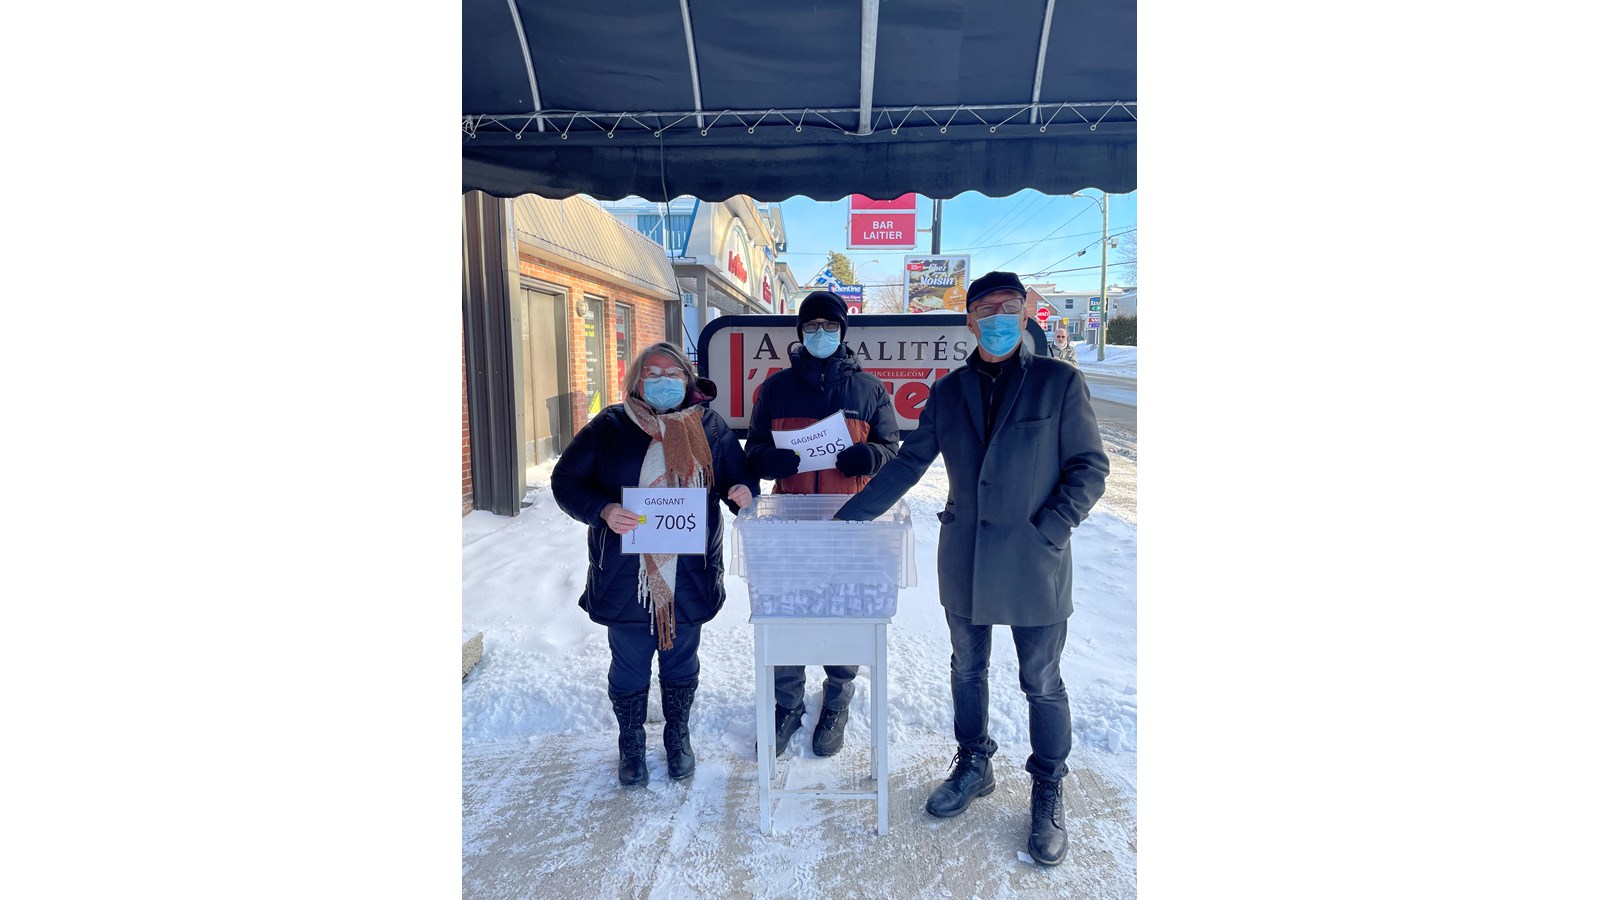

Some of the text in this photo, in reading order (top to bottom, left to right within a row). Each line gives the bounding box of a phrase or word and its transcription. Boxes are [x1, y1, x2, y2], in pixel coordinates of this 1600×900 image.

[872, 220, 894, 230] BAR
[863, 231, 903, 240] LAITIER
[920, 274, 954, 286] Voisin
[790, 430, 827, 445] GAGNANT
[806, 437, 846, 458] 250$
[655, 513, 696, 532] 700$
